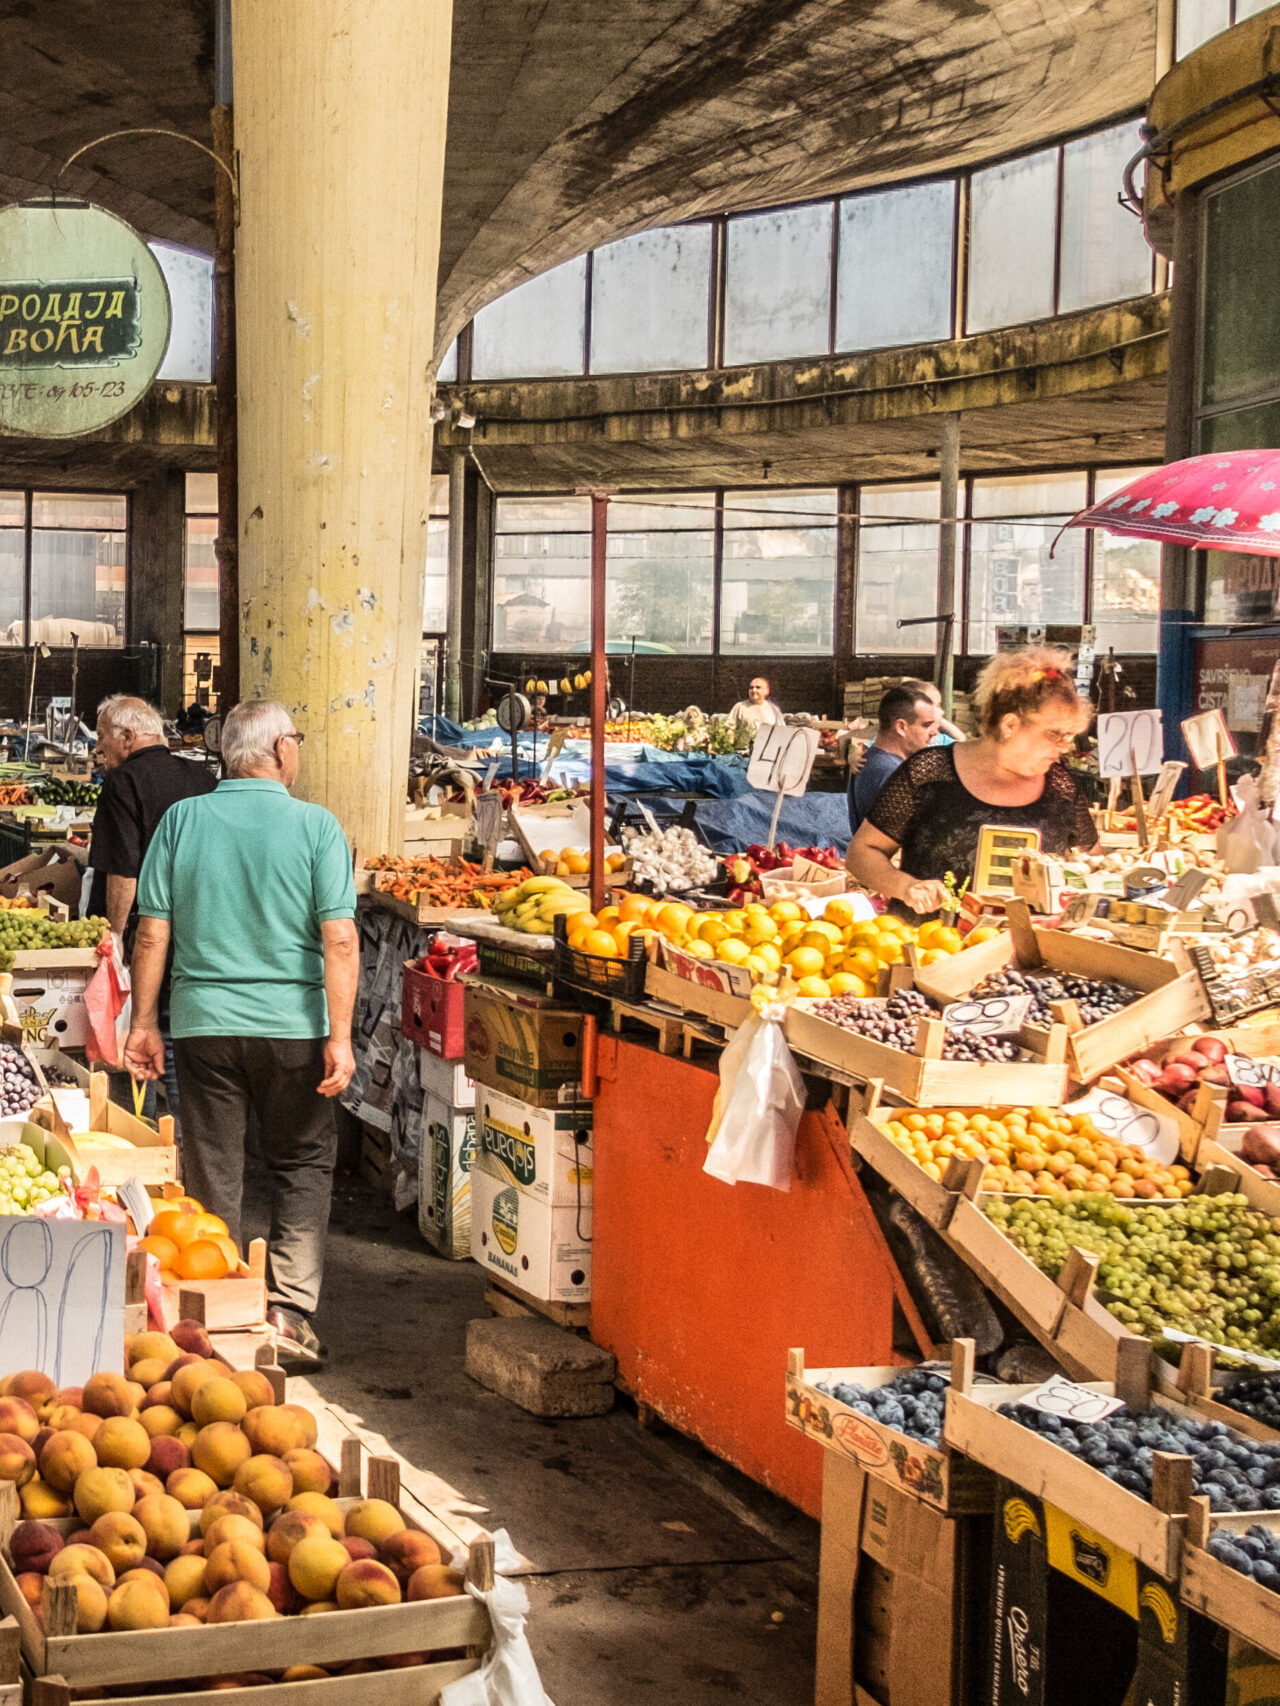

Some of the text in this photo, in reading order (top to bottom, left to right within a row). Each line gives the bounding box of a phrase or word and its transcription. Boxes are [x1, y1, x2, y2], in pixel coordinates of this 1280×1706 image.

[3, 321, 104, 355] ВОЋА
[757, 725, 810, 791] 40
[1103, 711, 1155, 772] 20
[484, 1125, 535, 1178] slobana
[487, 1251, 518, 1278] BANANAS
[1036, 1386, 1110, 1418] 80
[1006, 1605, 1031, 1697] Orsero
